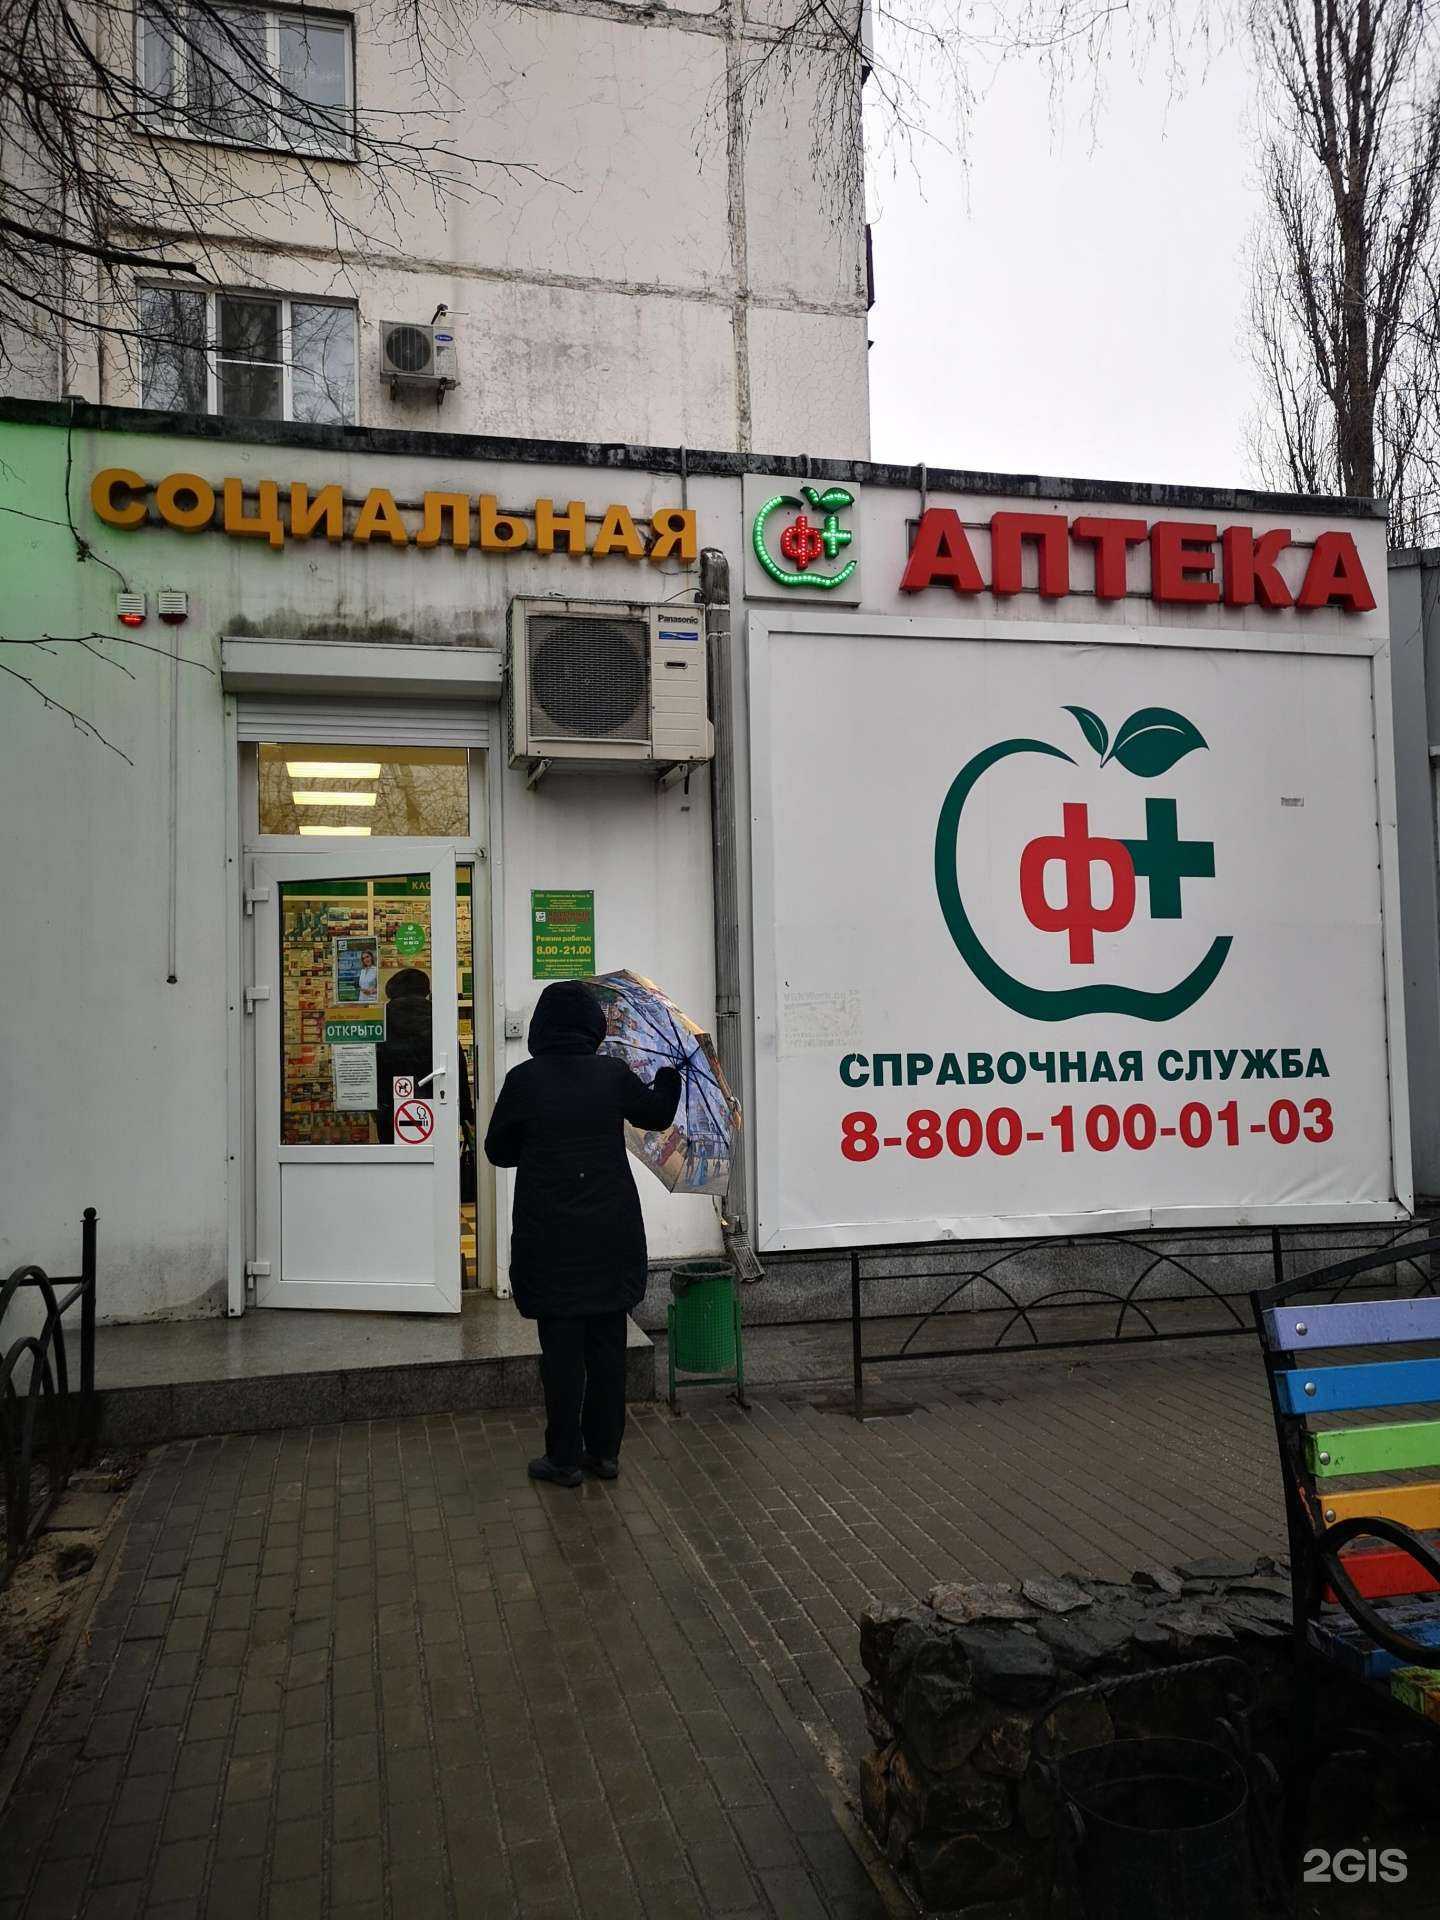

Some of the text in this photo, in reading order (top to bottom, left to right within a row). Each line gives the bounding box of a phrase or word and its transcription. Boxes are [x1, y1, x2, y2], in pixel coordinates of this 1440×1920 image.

[91, 468, 697, 562] СОЦИАЛЬНАЯ
[901, 508, 1377, 613] АПТЕКА
[657, 614, 699, 624] Panasonic
[327, 1024, 383, 1037] ОТКРЫТО
[839, 1048, 1330, 1088] СПРАВОЧНАЯ СЛУЖБА
[840, 1097, 1334, 1162] 8-800-100-01-03
